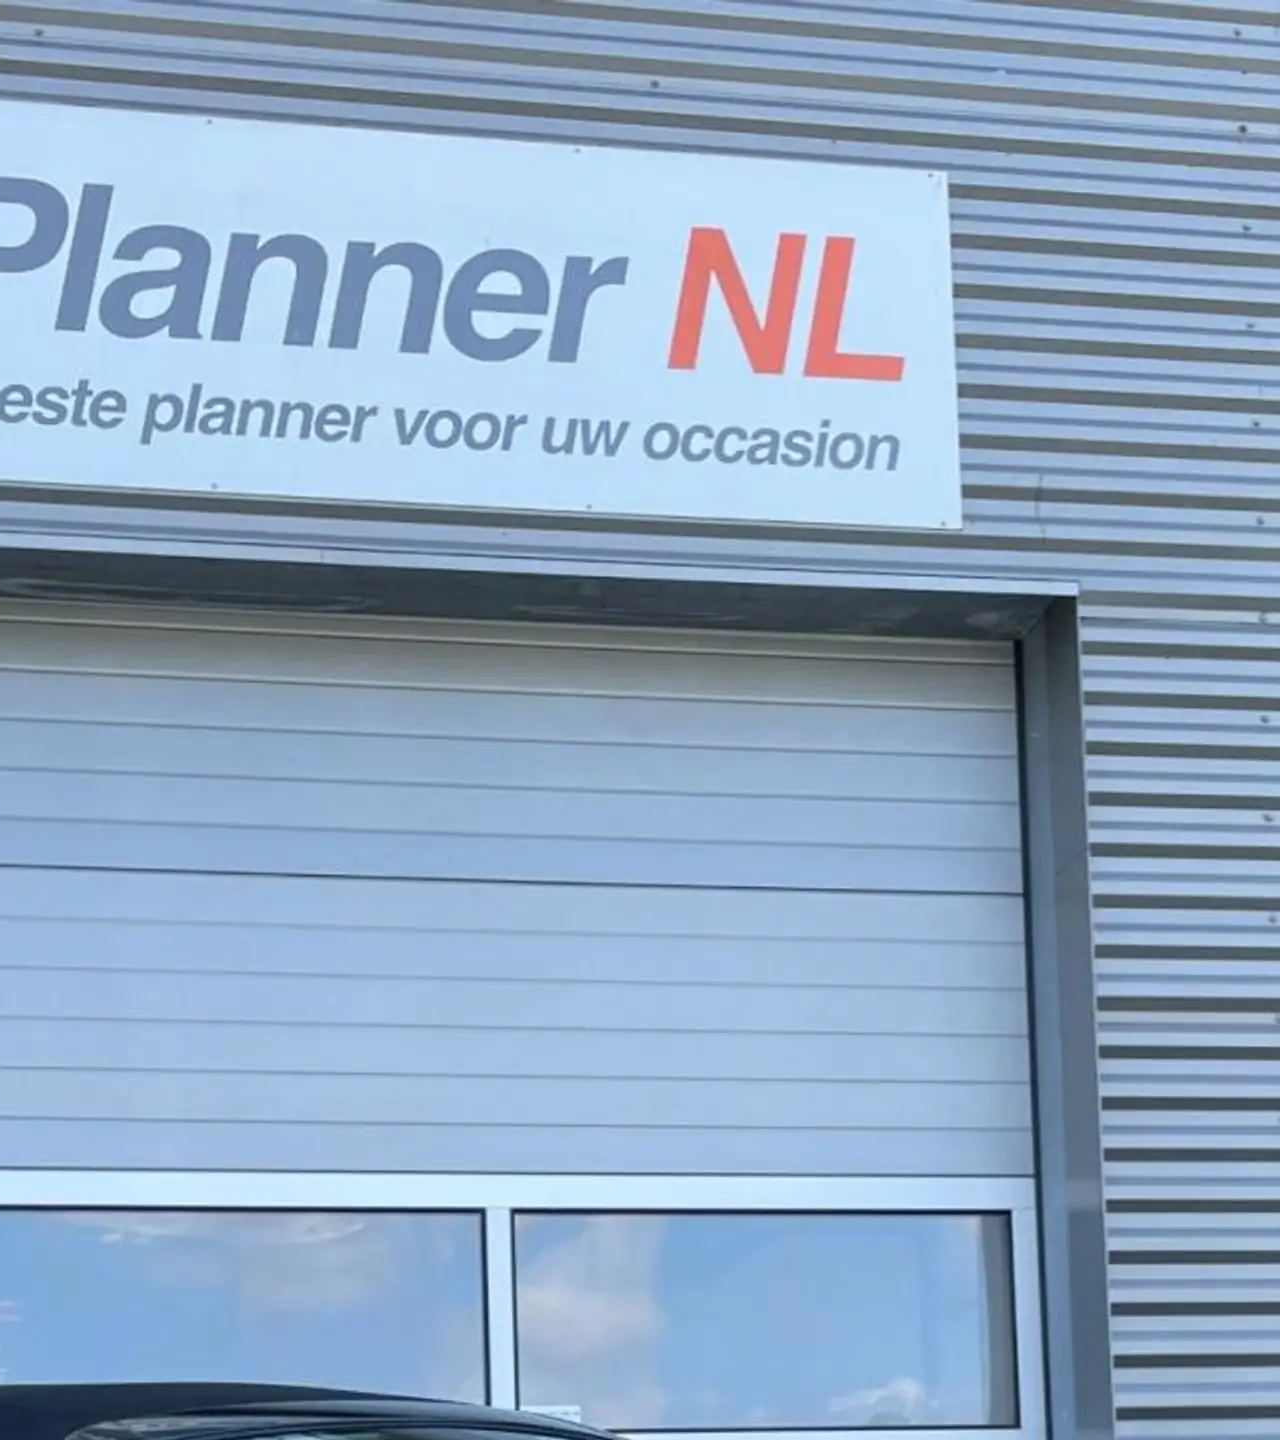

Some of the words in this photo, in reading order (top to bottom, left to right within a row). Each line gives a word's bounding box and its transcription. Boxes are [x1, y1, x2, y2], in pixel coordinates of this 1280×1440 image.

[668, 228, 903, 381] NL
[139, 383, 379, 445] planner
[393, 408, 528, 451] voor
[542, 416, 630, 457] uw
[643, 422, 900, 471] occasion
